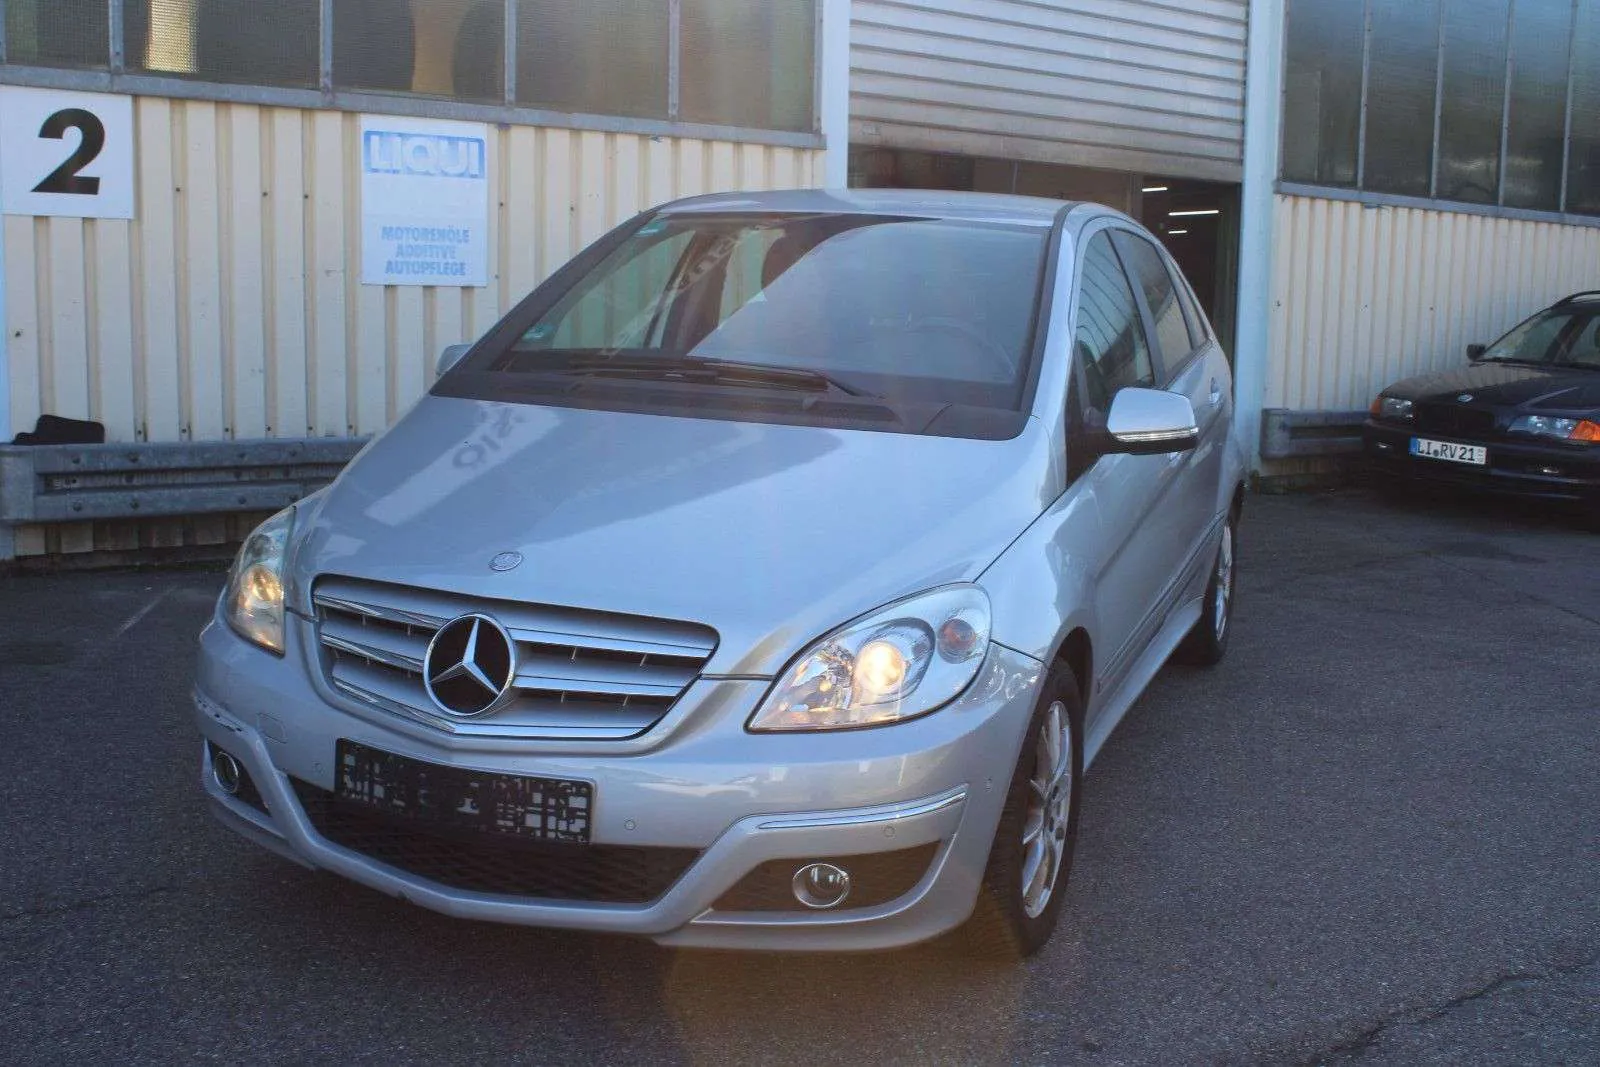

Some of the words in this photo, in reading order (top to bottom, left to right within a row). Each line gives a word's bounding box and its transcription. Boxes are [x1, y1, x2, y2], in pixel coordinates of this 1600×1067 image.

[31, 107, 106, 195] 2
[370, 135, 480, 175] LIQUI
[381, 226, 470, 244] MOTORENÖLE
[395, 244, 456, 260] ADDITIVE
[384, 260, 466, 276] AUTOPFLEGE
